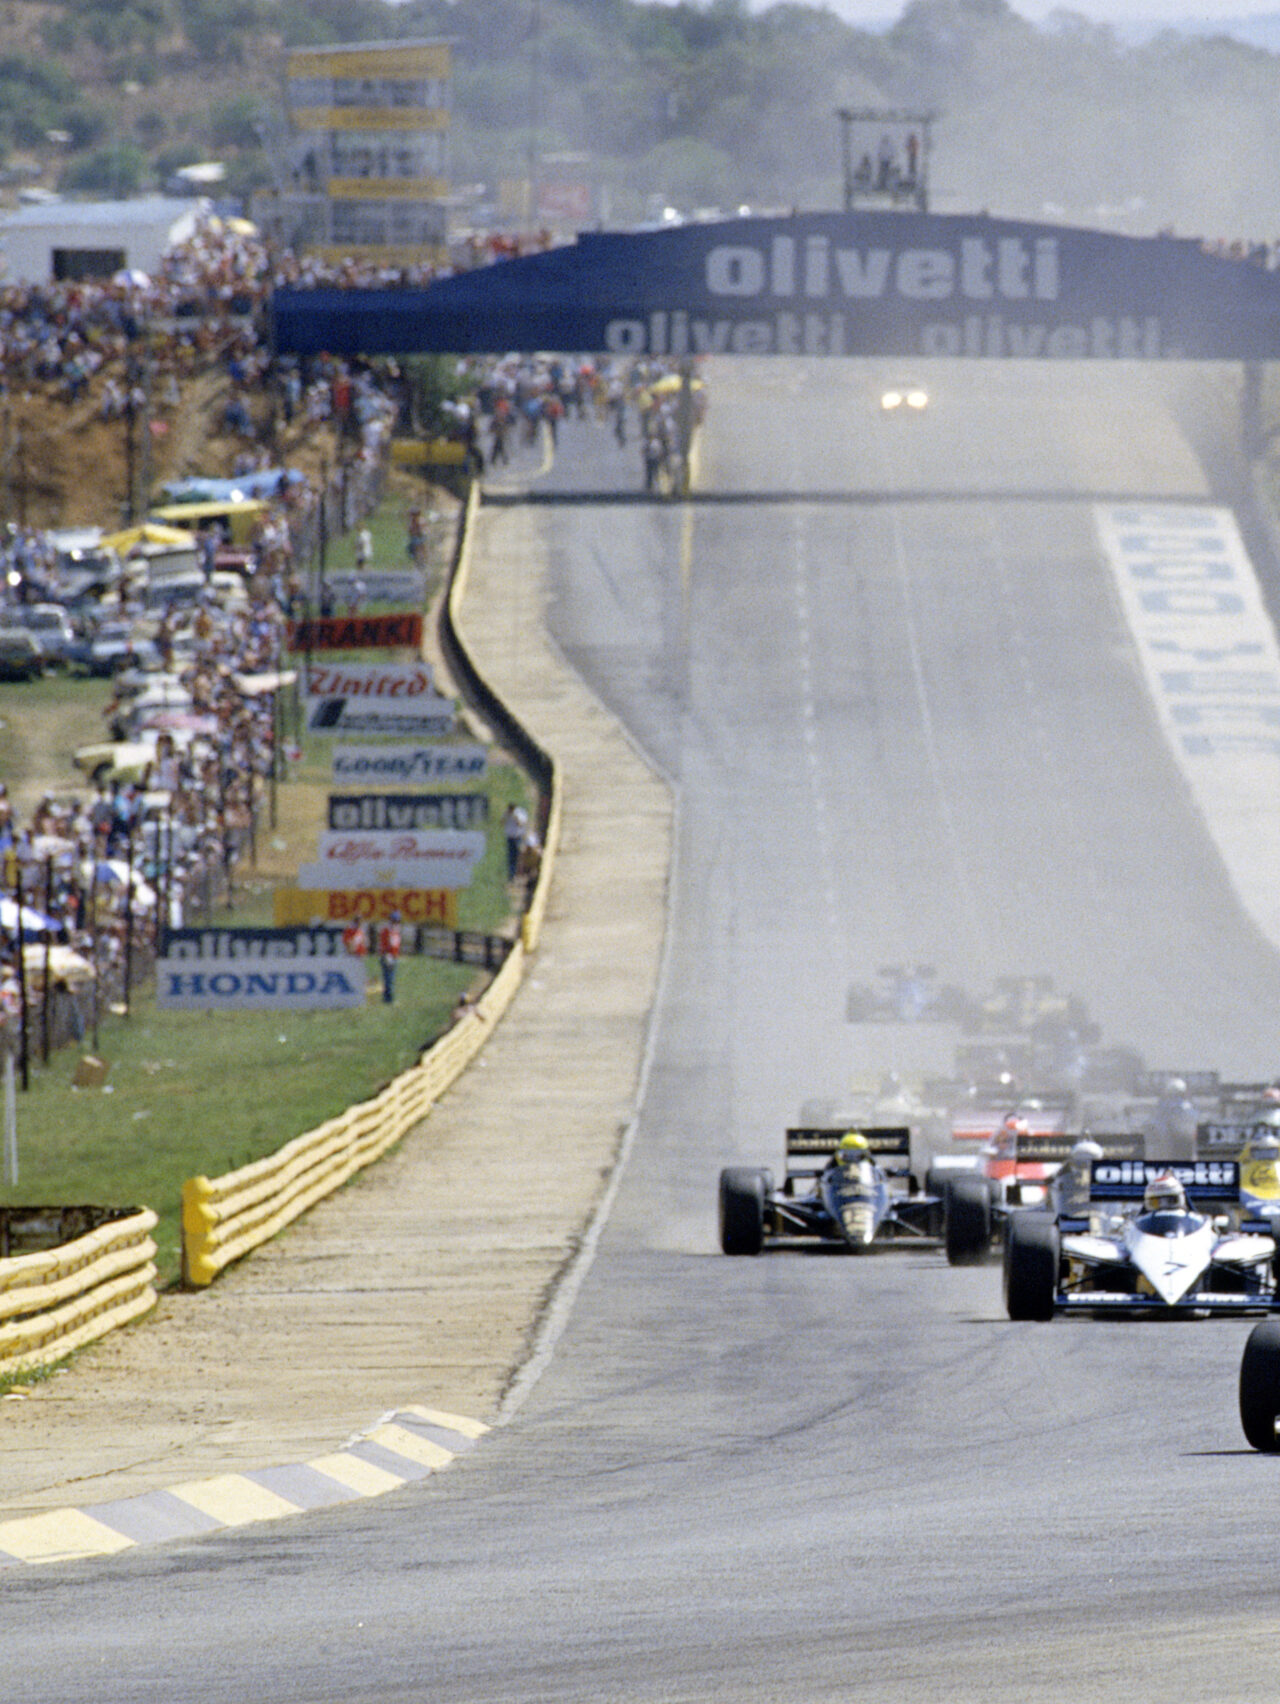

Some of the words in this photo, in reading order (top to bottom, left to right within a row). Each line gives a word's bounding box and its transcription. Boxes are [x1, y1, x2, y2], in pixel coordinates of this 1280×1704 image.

[705, 235, 1059, 300] olivetti
[605, 309, 847, 356] olivetti
[921, 315, 1162, 357] olivetti
[327, 891, 448, 919] BOSCH
[167, 970, 354, 996] HONDA
